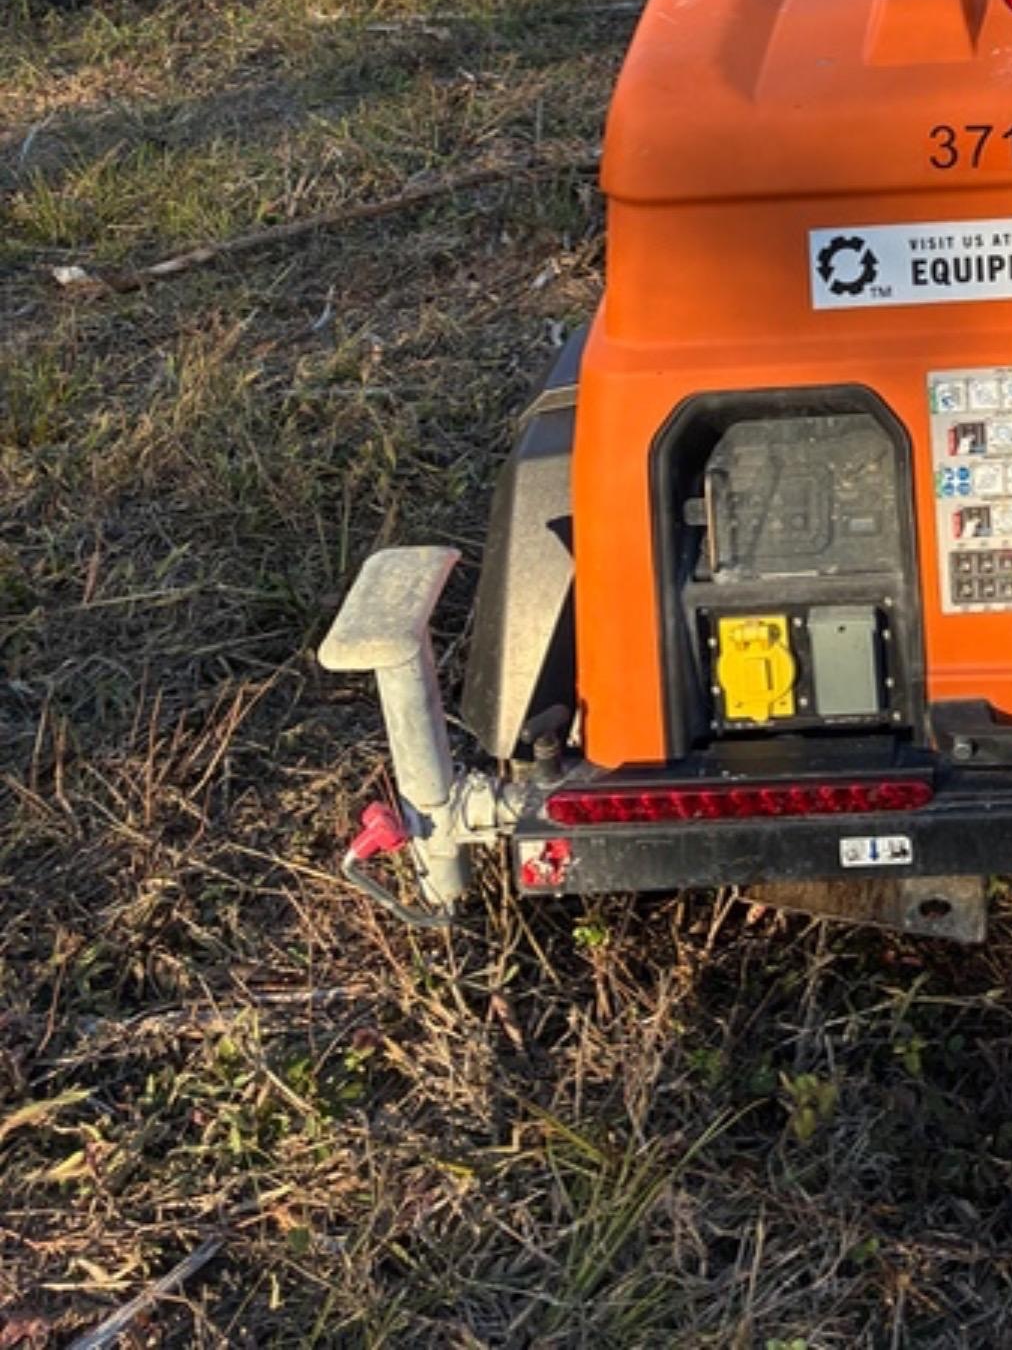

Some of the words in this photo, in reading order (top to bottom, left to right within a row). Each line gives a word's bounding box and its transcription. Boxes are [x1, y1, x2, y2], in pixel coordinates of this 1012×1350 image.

[909, 236, 954, 251] VISIT
[962, 233, 985, 249] US
[870, 285, 892, 298] TM
